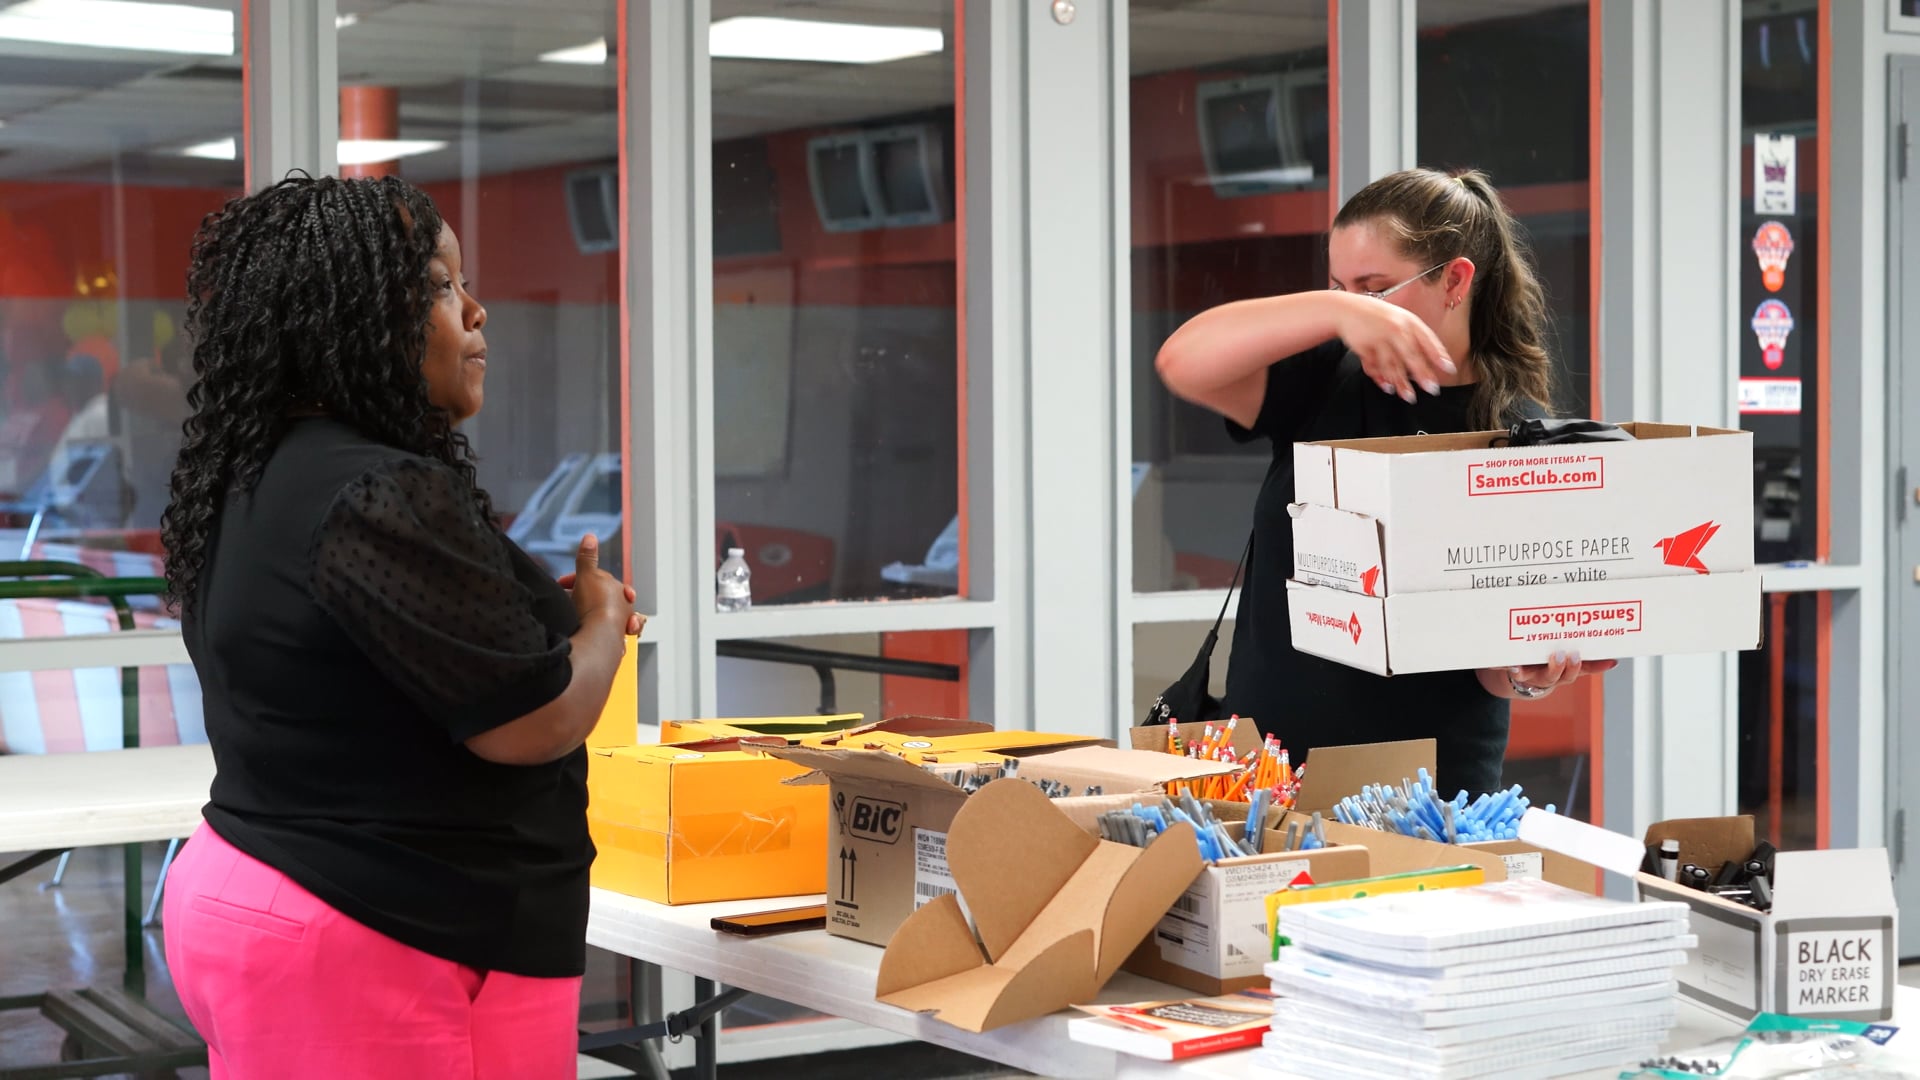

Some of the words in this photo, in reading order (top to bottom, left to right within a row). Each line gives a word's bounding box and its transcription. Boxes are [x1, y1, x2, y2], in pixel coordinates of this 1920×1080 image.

[1486, 460, 1507, 469] SHOP
[1509, 459, 1524, 467] FOR
[1526, 457, 1549, 466] MORE
[1550, 456, 1575, 465] ITEMS
[1576, 455, 1587, 463] AT
[1475, 469, 1597, 489] SamsClub.com
[1447, 540, 1575, 565] MULTIPURPOSE
[1581, 537, 1631, 557] PAPER
[1470, 573, 1513, 590] letter
[1517, 570, 1548, 587] size
[1563, 567, 1607, 583] white
[1516, 608, 1635, 627] SamsClub.com
[1526, 633, 1537, 641] AT
[1538, 631, 1562, 640] ITEMS
[1563, 630, 1586, 639] MORE
[1587, 629, 1603, 637] FOR
[1604, 628, 1625, 636] SHOP
[1798, 937, 1872, 964] BLACK
[1799, 968, 1827, 982] DRY
[1831, 966, 1871, 981] ERASE
[1799, 984, 1870, 1006] MARKER
